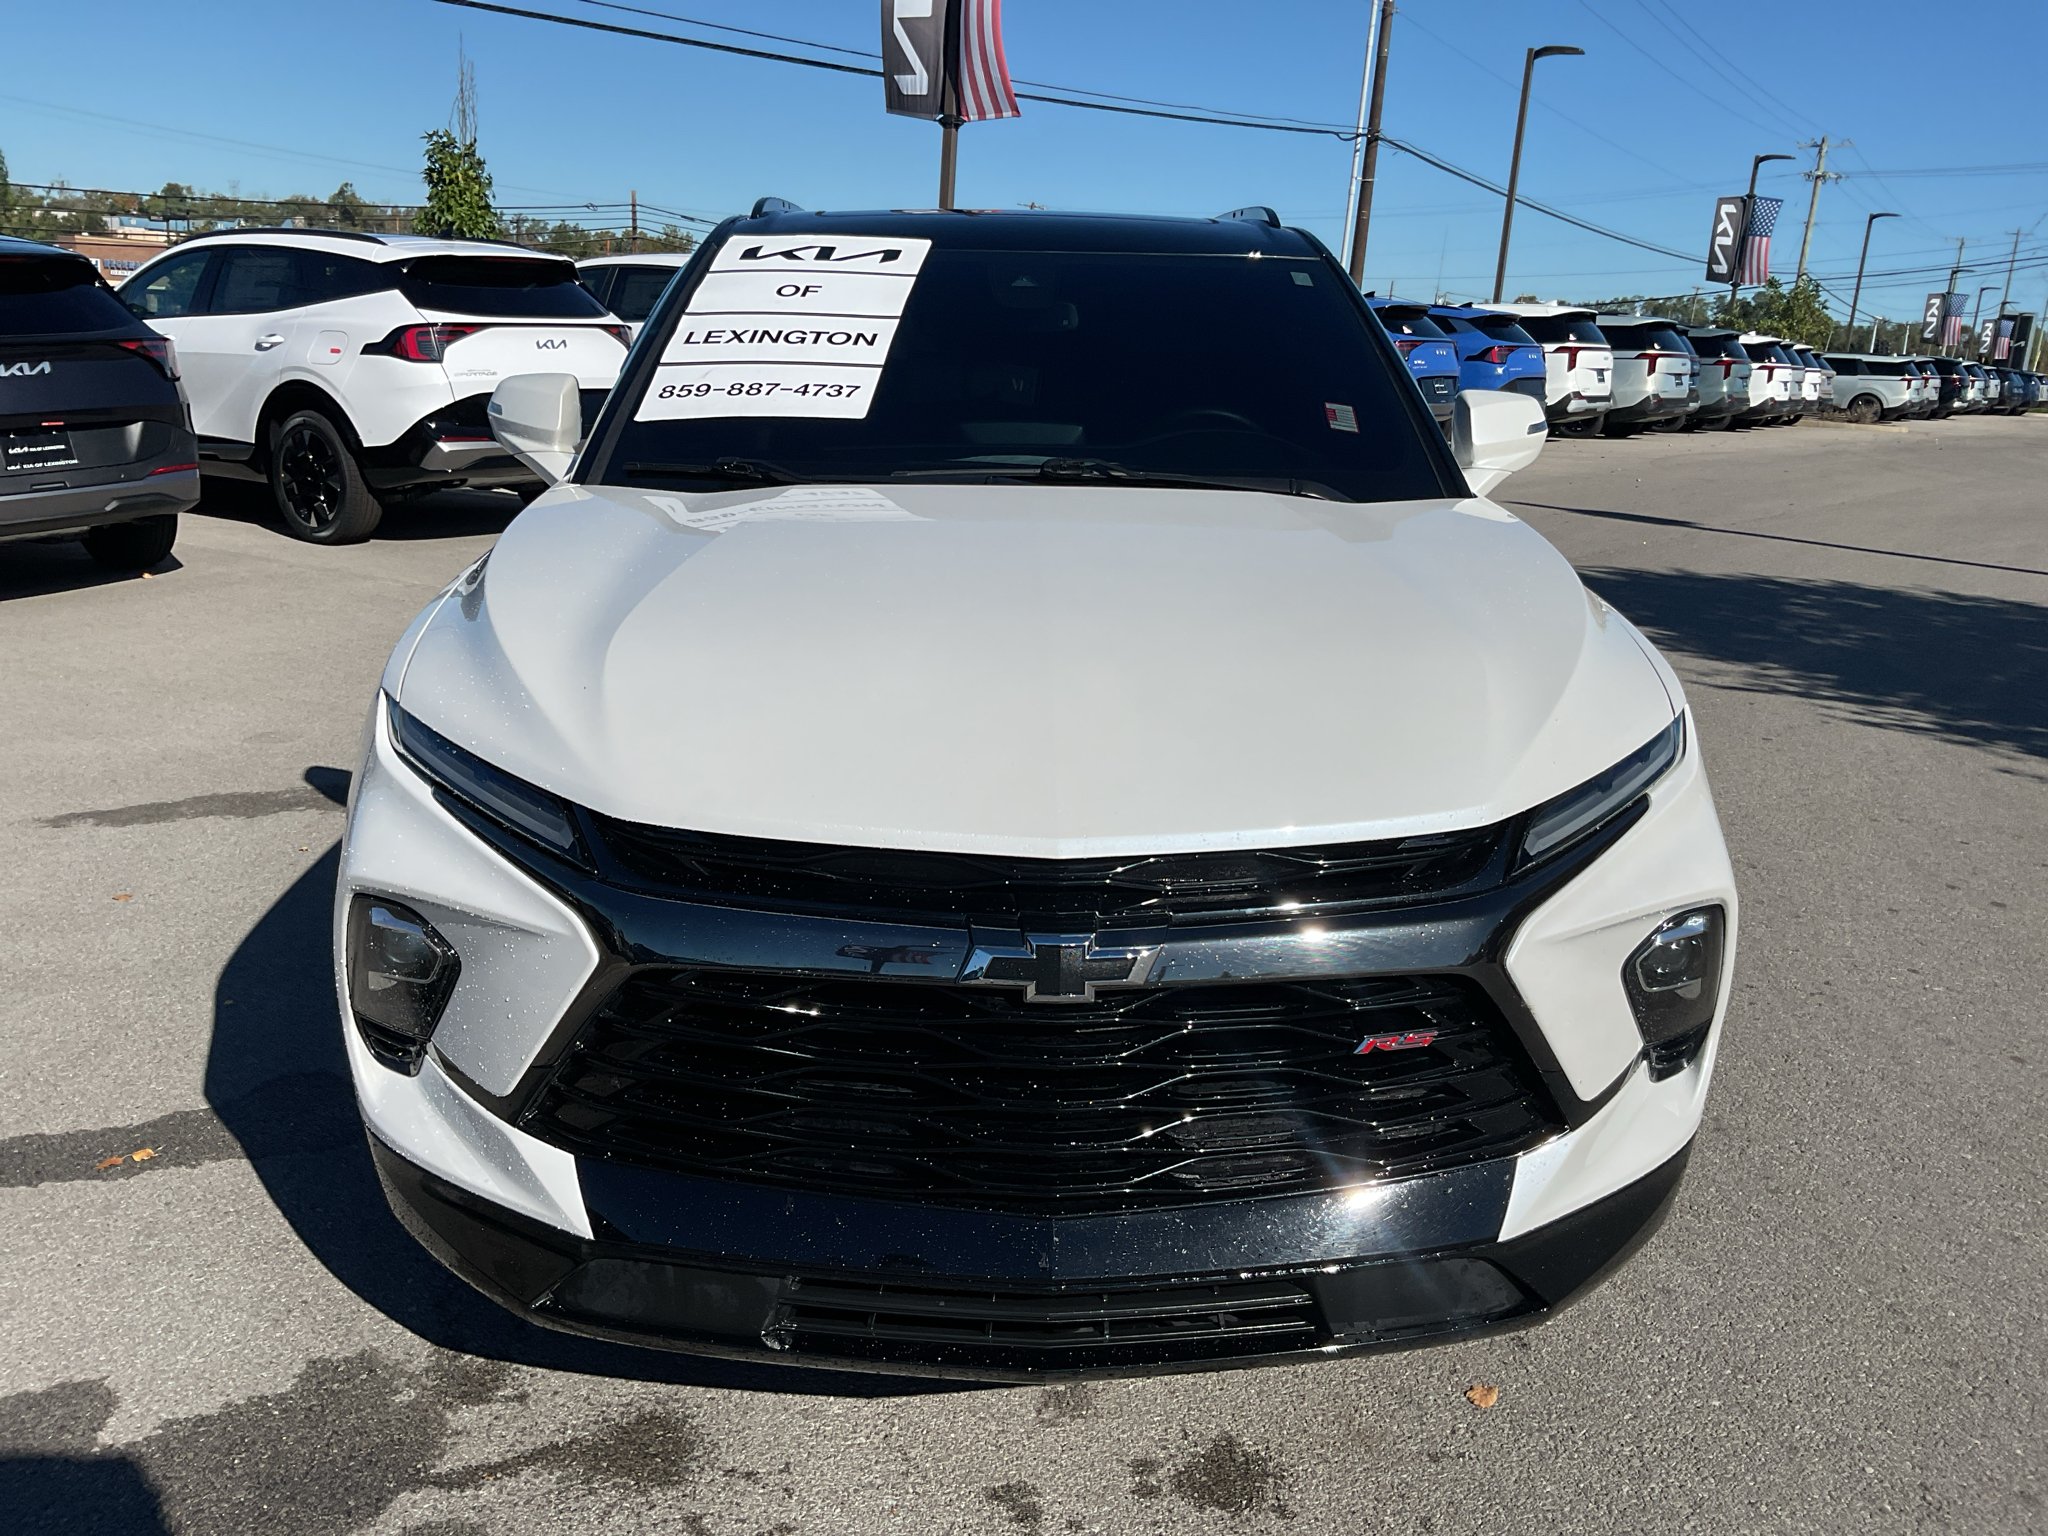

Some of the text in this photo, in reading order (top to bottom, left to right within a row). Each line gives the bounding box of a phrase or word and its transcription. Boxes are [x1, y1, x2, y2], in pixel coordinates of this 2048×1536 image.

[739, 245, 903, 263] KIA
[776, 284, 822, 298] OF
[536, 339, 568, 350] KIA
[683, 329, 878, 346] LEXINGTON
[658, 383, 861, 399] 859-887-4737
[1353, 1029, 1439, 1055] RS
